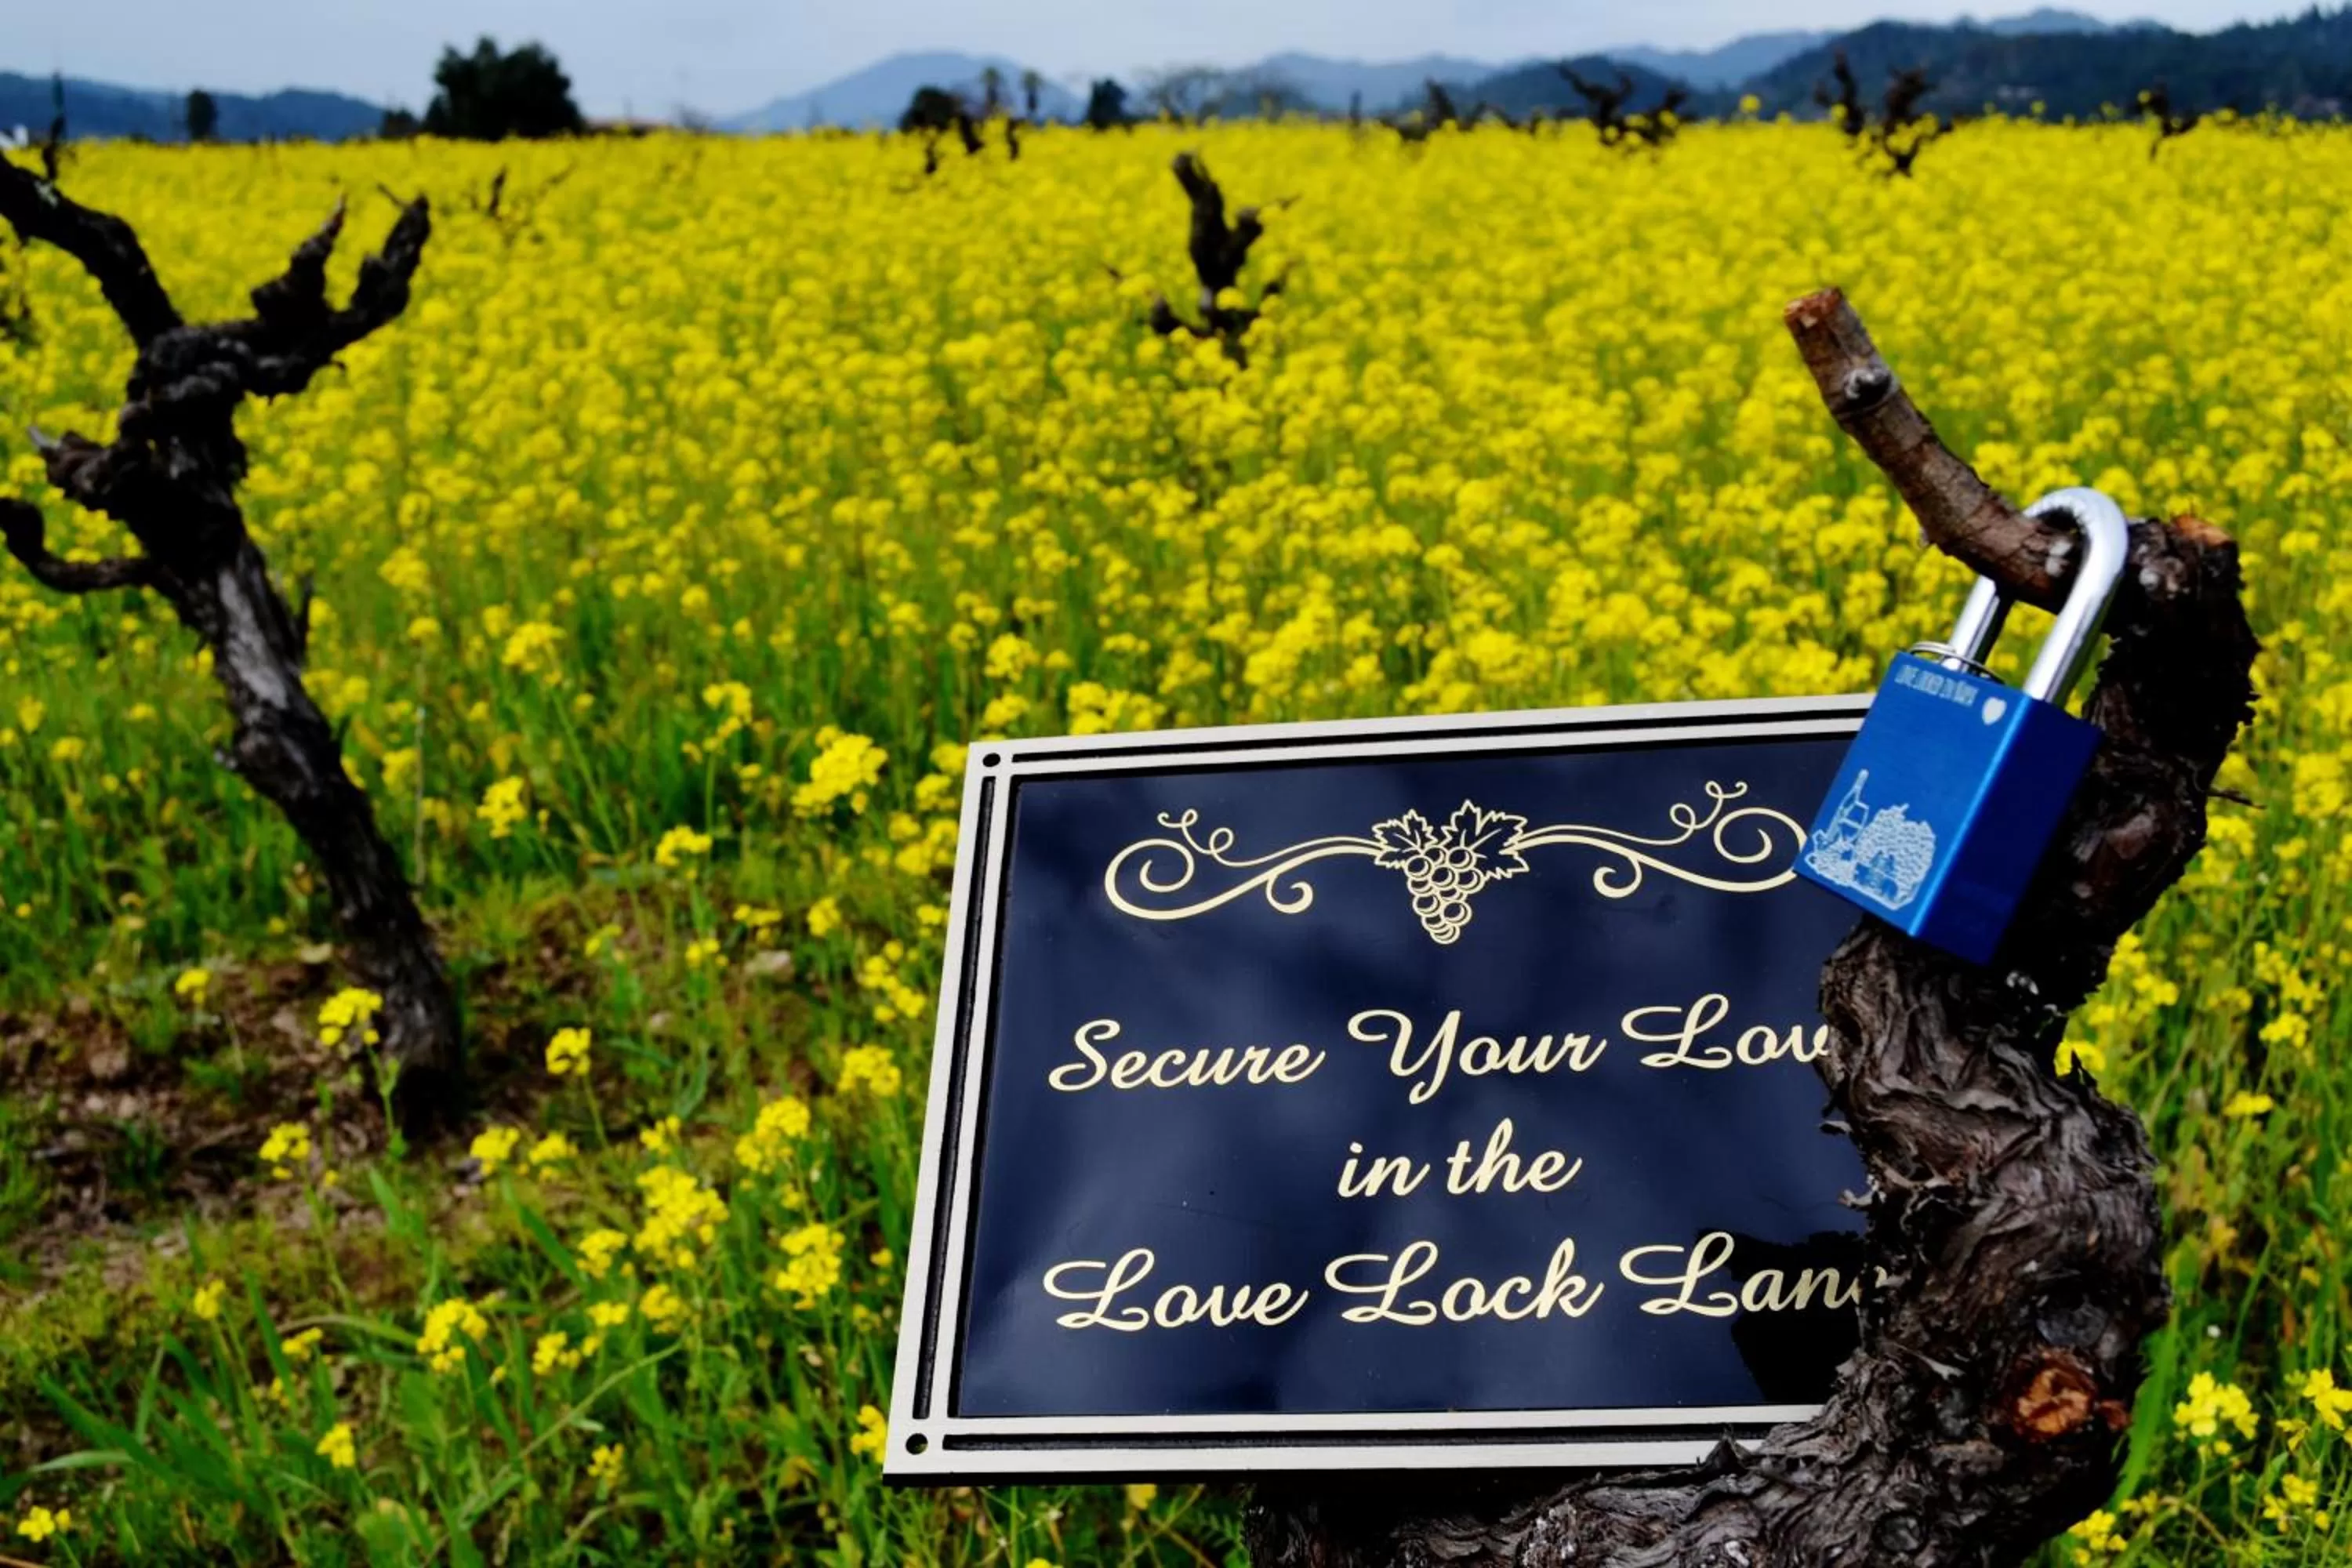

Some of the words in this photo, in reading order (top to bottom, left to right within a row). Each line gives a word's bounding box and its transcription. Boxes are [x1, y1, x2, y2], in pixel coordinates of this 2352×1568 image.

[1047, 1018, 1327, 1091] Secure
[1346, 1008, 1608, 1105] Your
[1620, 993, 1831, 1069] Lov
[1337, 1142, 1431, 1198] in
[1445, 1117, 1583, 1196] the
[1041, 1247, 1310, 1332] Love
[1323, 1237, 1605, 1326] Lock
